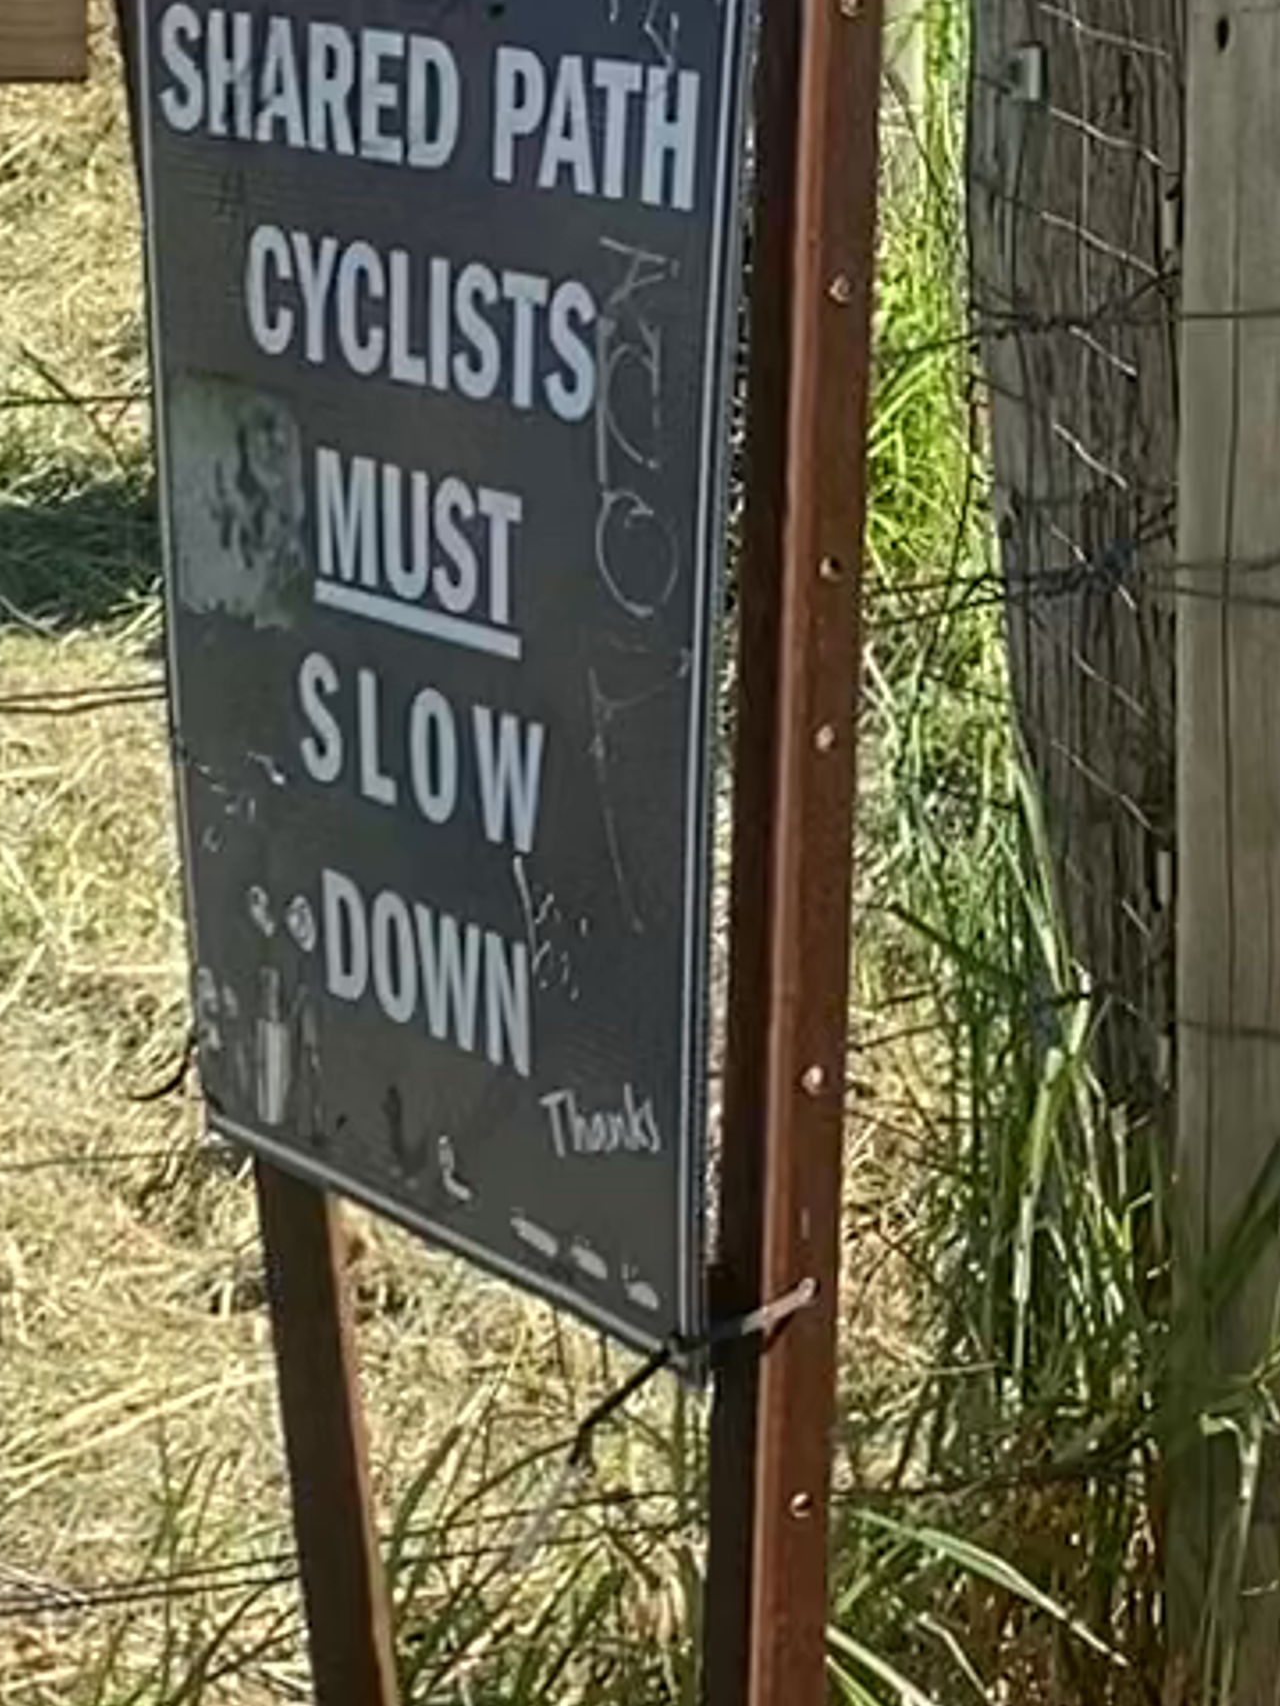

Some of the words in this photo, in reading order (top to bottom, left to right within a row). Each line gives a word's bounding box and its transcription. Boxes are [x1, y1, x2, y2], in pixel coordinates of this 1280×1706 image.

[158, 1, 460, 169] SHARED
[493, 47, 701, 212] PATH
[245, 224, 599, 423] CYCLISTS
[315, 446, 523, 625] MUST
[298, 651, 545, 854] SLOW
[321, 868, 532, 1078] DOWN
[540, 1083, 662, 1159] Thanks
